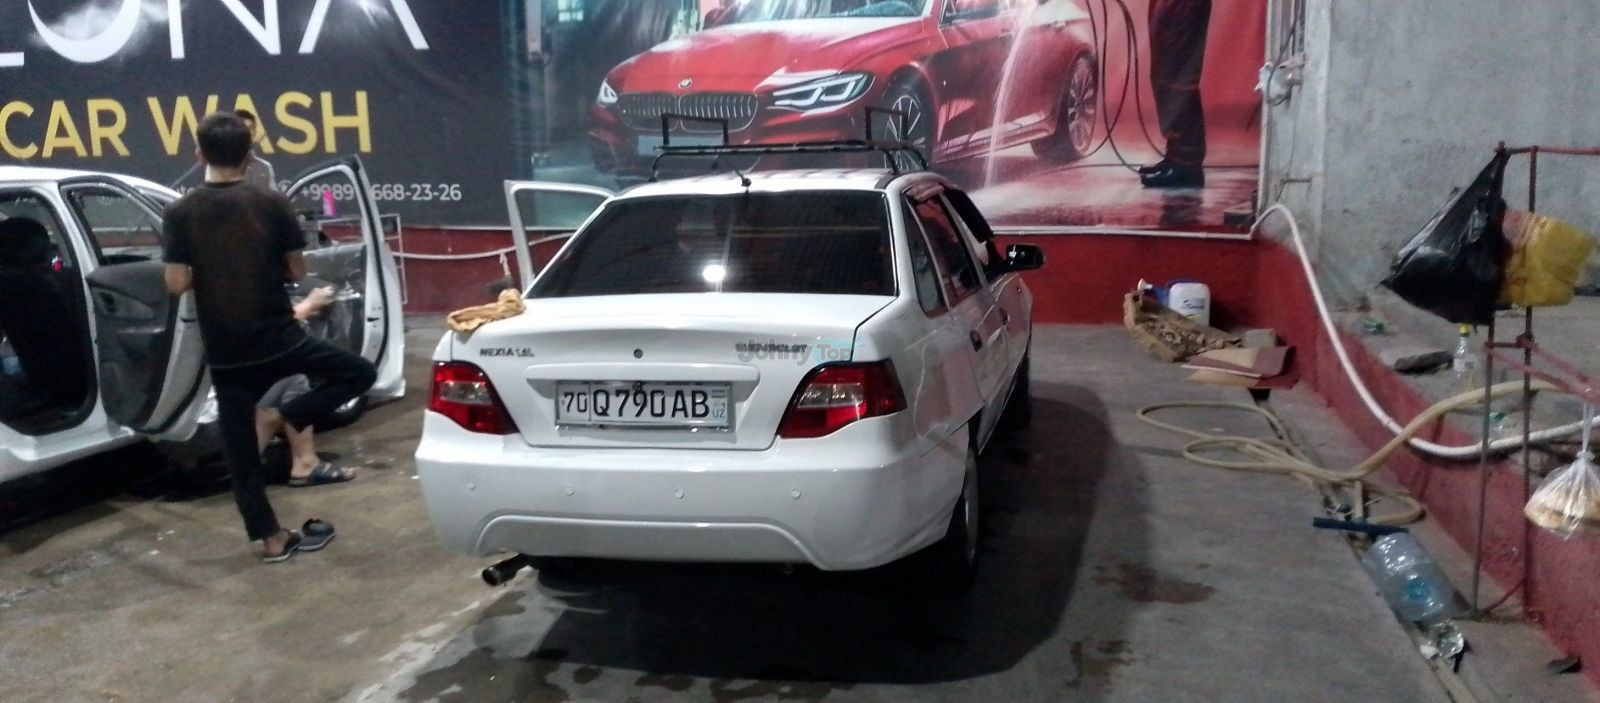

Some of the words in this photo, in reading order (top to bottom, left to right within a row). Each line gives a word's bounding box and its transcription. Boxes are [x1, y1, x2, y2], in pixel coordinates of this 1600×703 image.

[0, 99, 131, 159] CAR
[147, 91, 372, 156] WASH
[480, 348, 514, 357] NEXIA
[563, 391, 589, 414] 70
[712, 408, 726, 419] UZ
